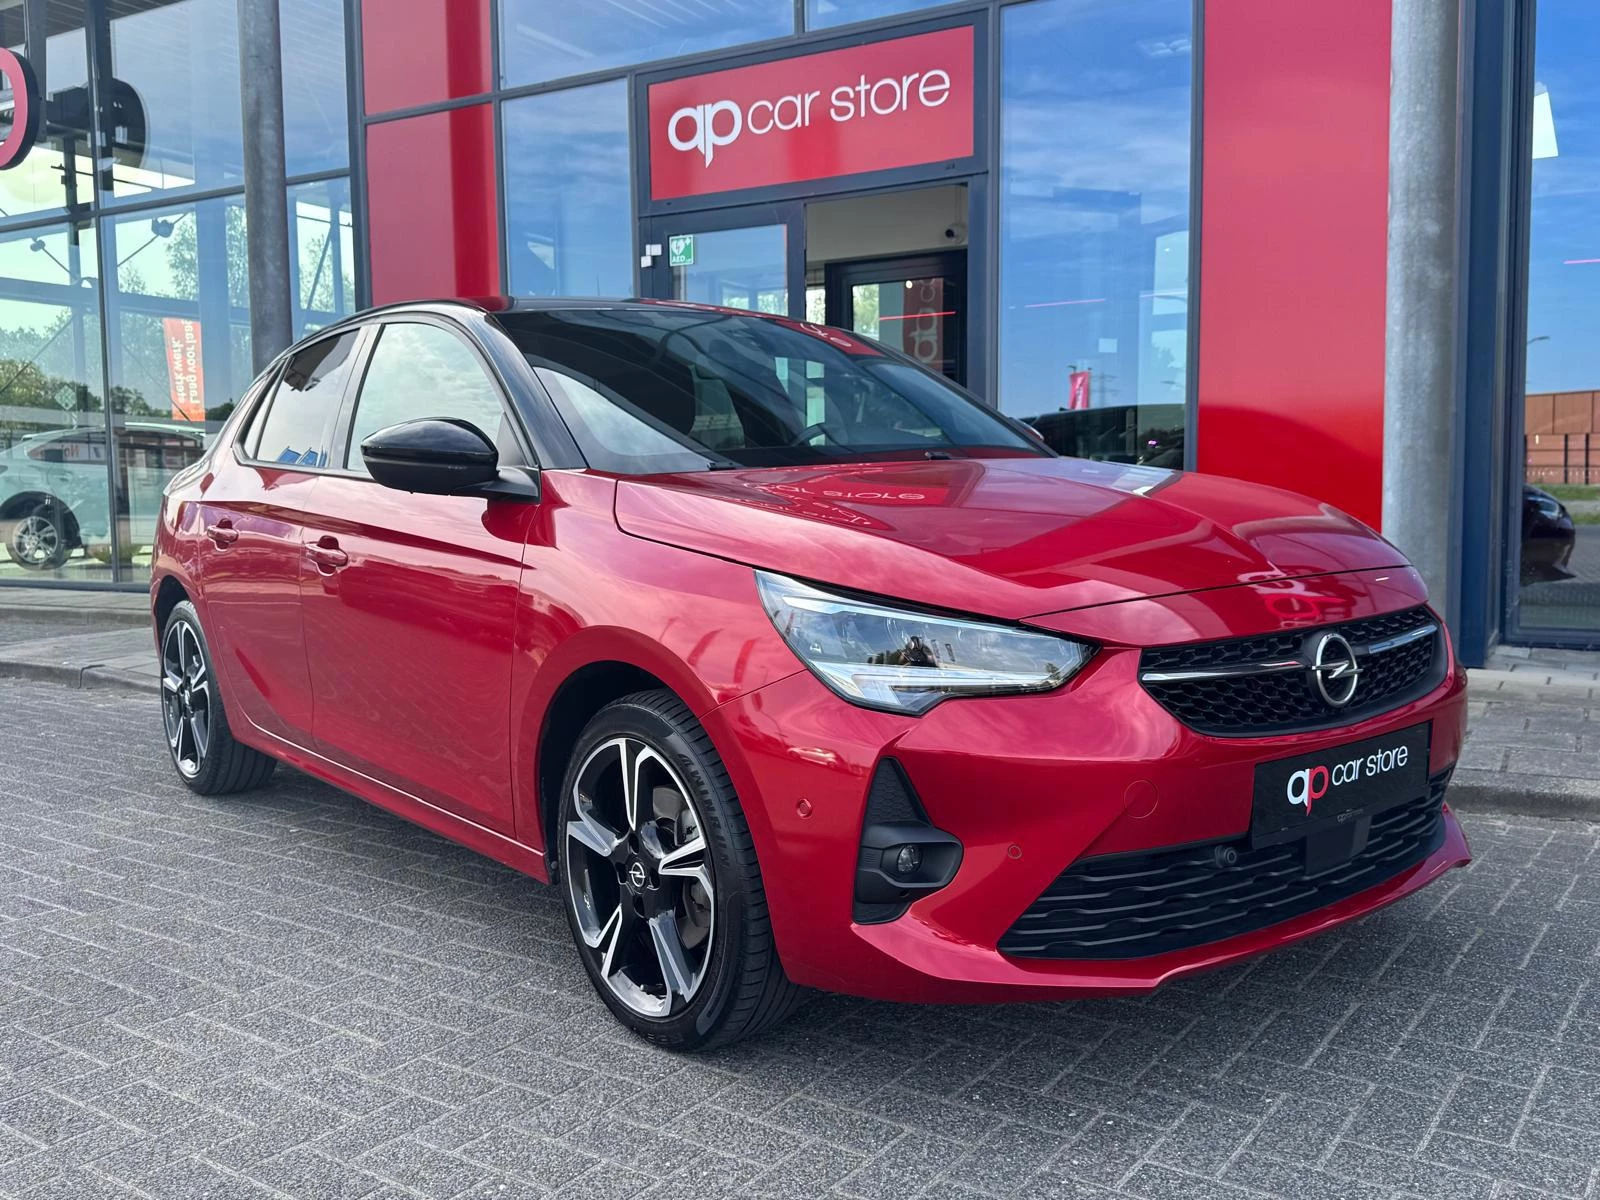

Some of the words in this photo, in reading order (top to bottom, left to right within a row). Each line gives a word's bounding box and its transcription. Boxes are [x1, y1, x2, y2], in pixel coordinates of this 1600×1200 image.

[668, 100, 742, 168] ap
[747, 91, 820, 134] car
[830, 69, 950, 122] store
[1287, 765, 1329, 816] ap
[1332, 758, 1364, 786] car
[1366, 745, 1408, 776] store
